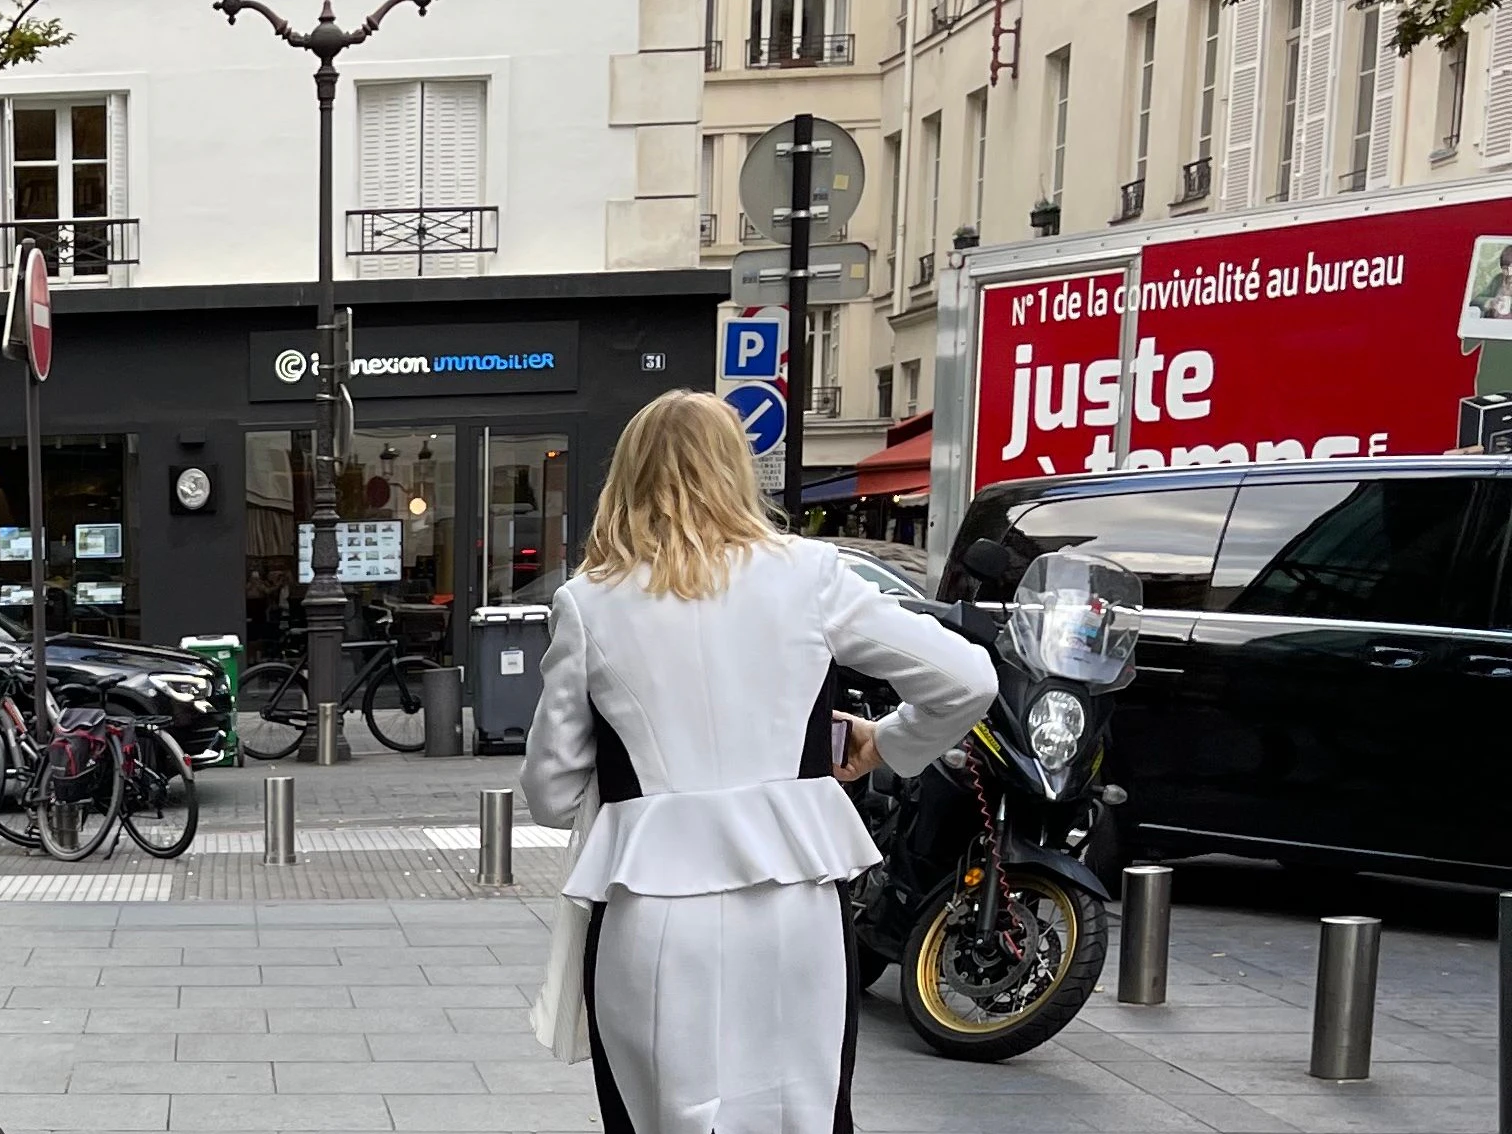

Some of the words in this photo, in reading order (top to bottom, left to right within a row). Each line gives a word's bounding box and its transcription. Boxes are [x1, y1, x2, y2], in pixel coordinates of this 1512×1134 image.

[1038, 287, 1048, 323] 1
[1053, 281, 1082, 322] de
[1087, 278, 1108, 317] la
[1113, 257, 1259, 314] convivialité
[1266, 267, 1299, 298] au
[1305, 251, 1405, 294] bureau
[645, 355, 662, 369] 31
[738, 331, 764, 368] P
[1001, 336, 1215, 462] juste
